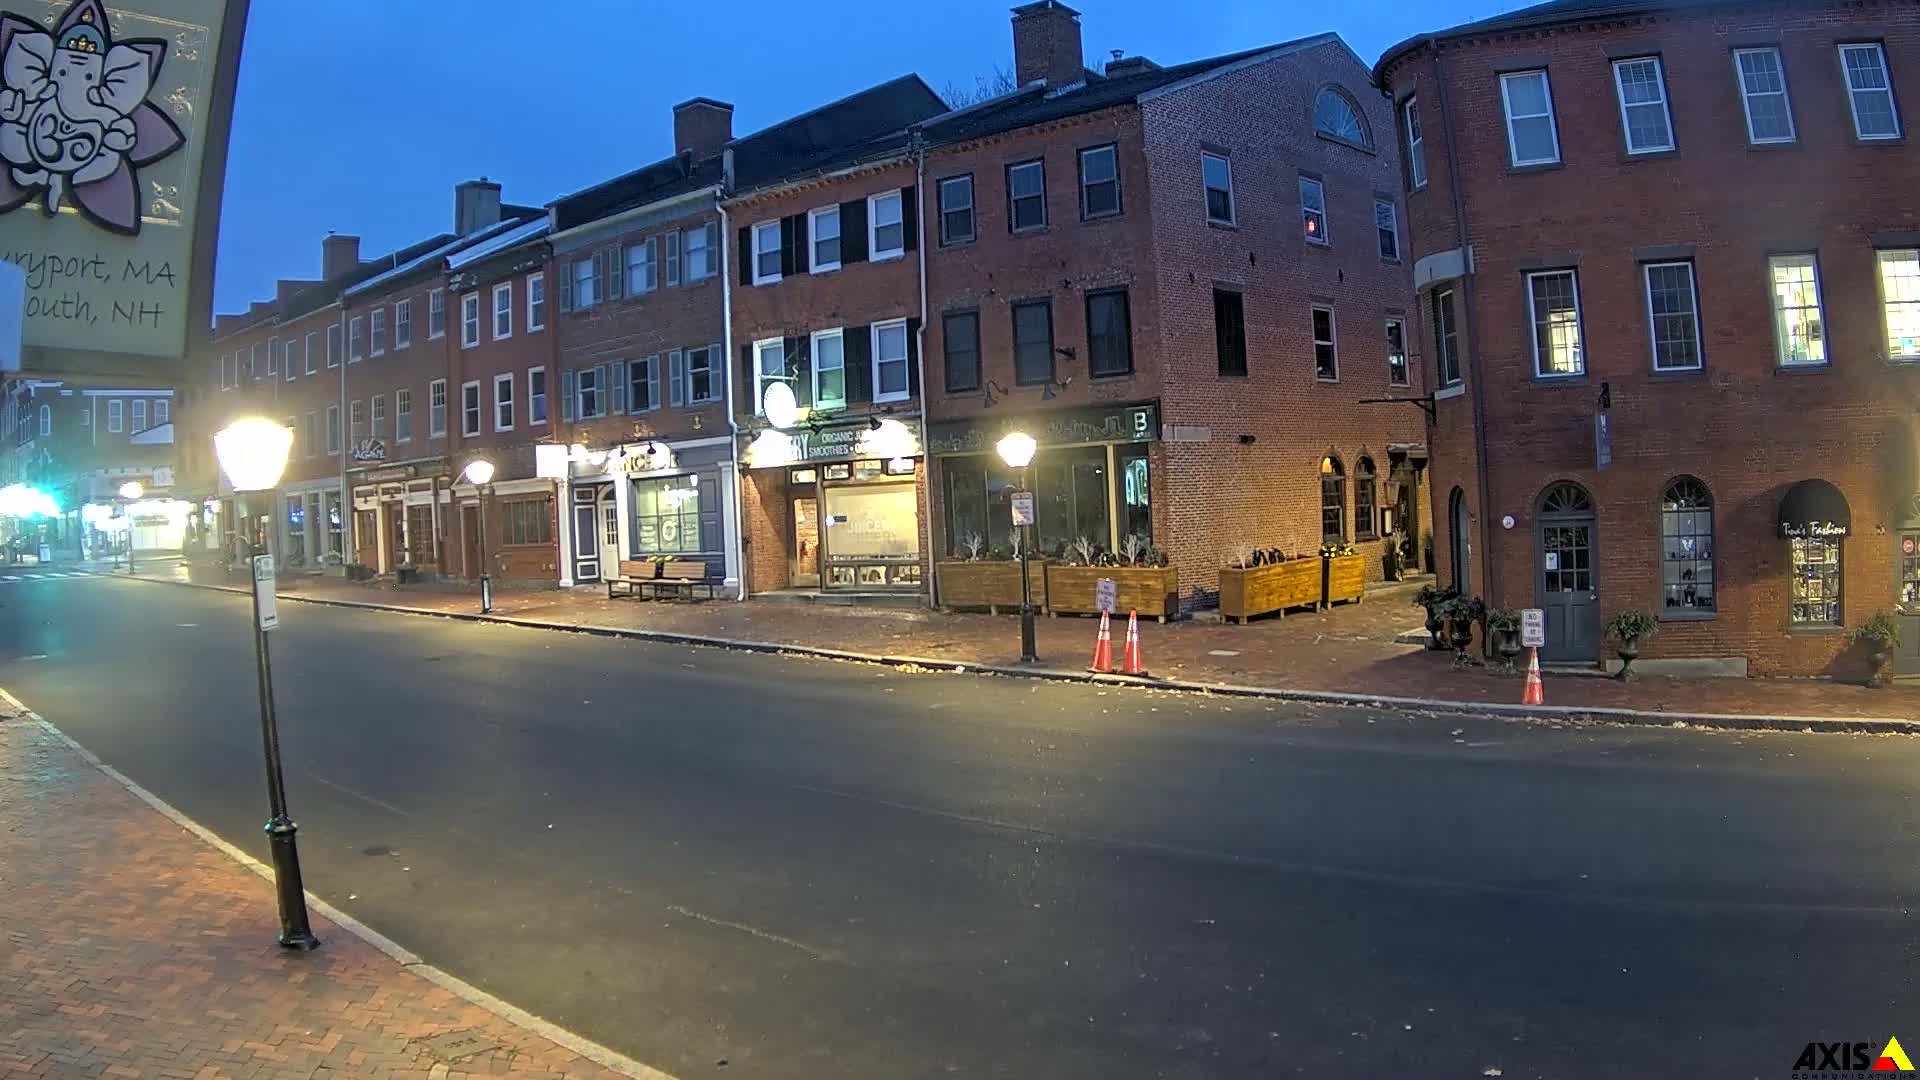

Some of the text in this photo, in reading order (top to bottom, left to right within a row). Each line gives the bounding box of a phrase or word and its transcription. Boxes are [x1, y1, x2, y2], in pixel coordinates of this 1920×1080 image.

[122, 261, 176, 288] MA
[112, 301, 164, 329] NH
[1134, 411, 1148, 431] B
[821, 431, 854, 443] ORGANIC
[808, 444, 849, 457] SMOOTHIES
[1809, 520, 1847, 536] Fashion
